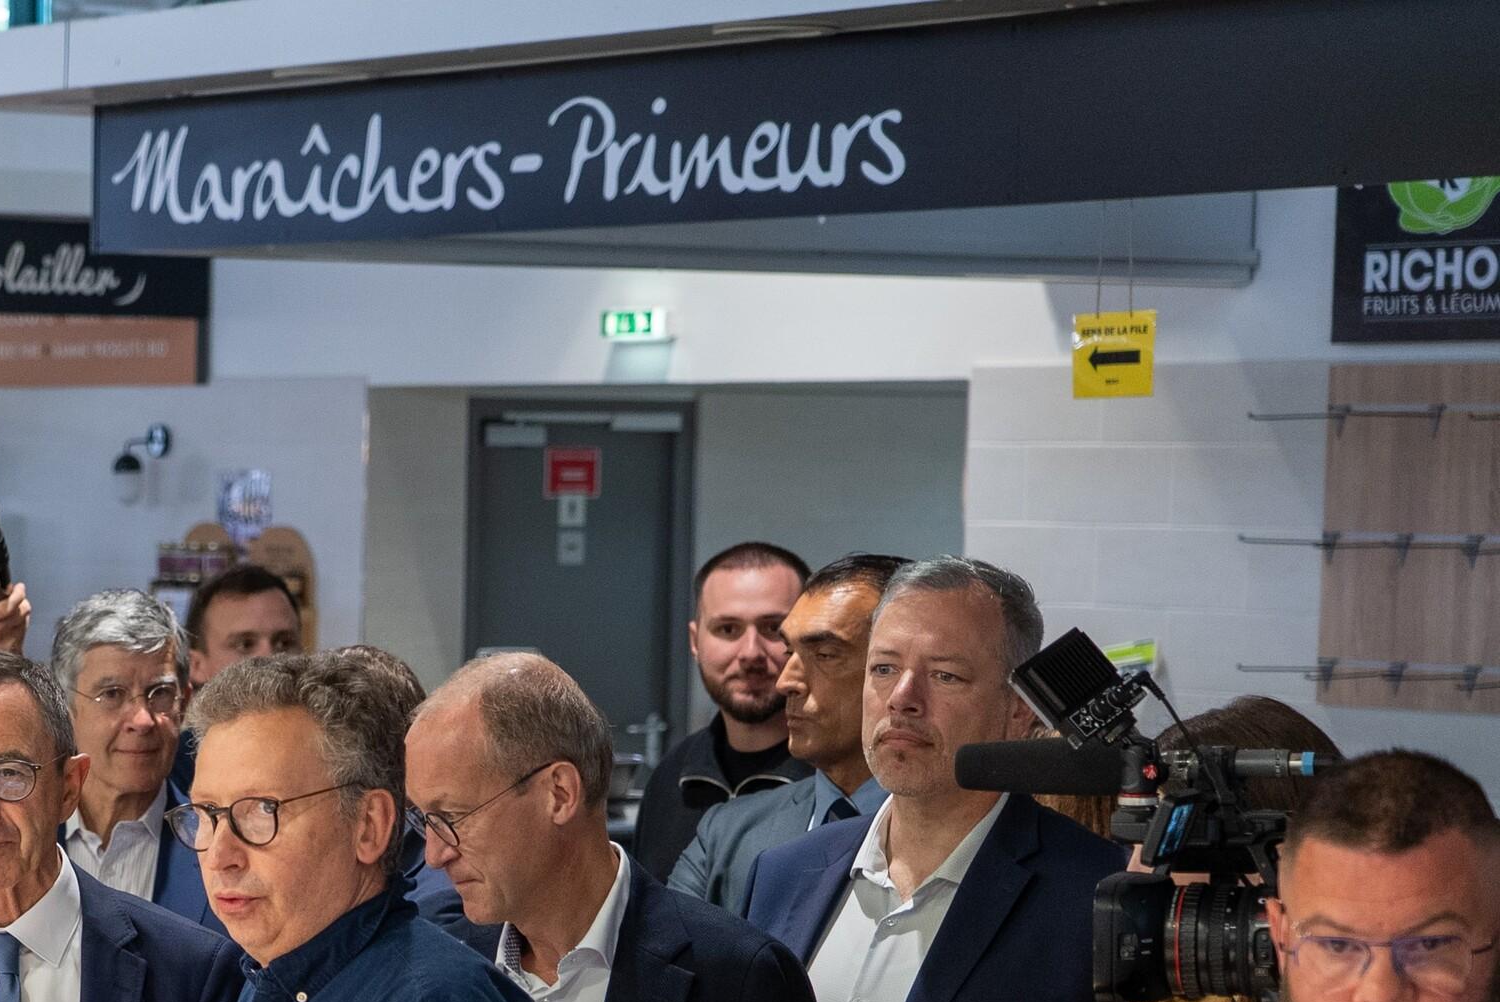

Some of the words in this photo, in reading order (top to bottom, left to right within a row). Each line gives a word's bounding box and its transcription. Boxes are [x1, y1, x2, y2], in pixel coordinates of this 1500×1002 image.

[547, 96, 906, 203] Primeurs
[1363, 245, 1499, 293] RICHO
[1363, 294, 1420, 316] FRUITS
[1425, 294, 1436, 315] &
[1104, 326, 1115, 336] DE
[1117, 326, 1127, 335] LA
